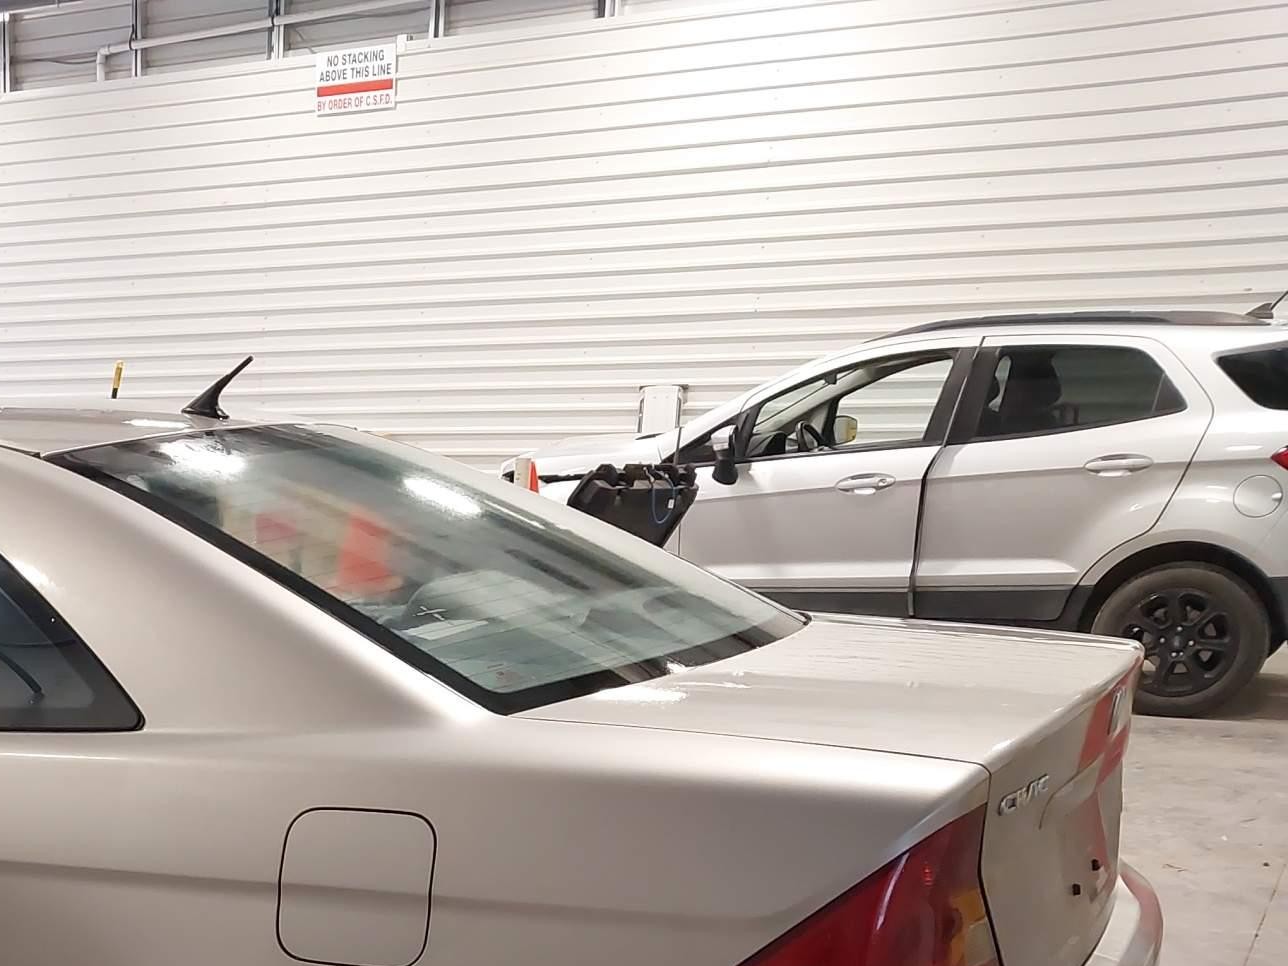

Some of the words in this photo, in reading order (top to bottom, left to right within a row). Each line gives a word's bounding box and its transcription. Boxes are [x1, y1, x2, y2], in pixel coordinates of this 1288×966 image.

[327, 55, 339, 66] NO
[342, 50, 385, 65] STACKING
[319, 68, 348, 82] ABOVE
[350, 65, 369, 79] THIS
[372, 64, 392, 76] LINE
[317, 101, 326, 111] BY
[328, 97, 352, 110] ORDER
[354, 96, 363, 107] OF
